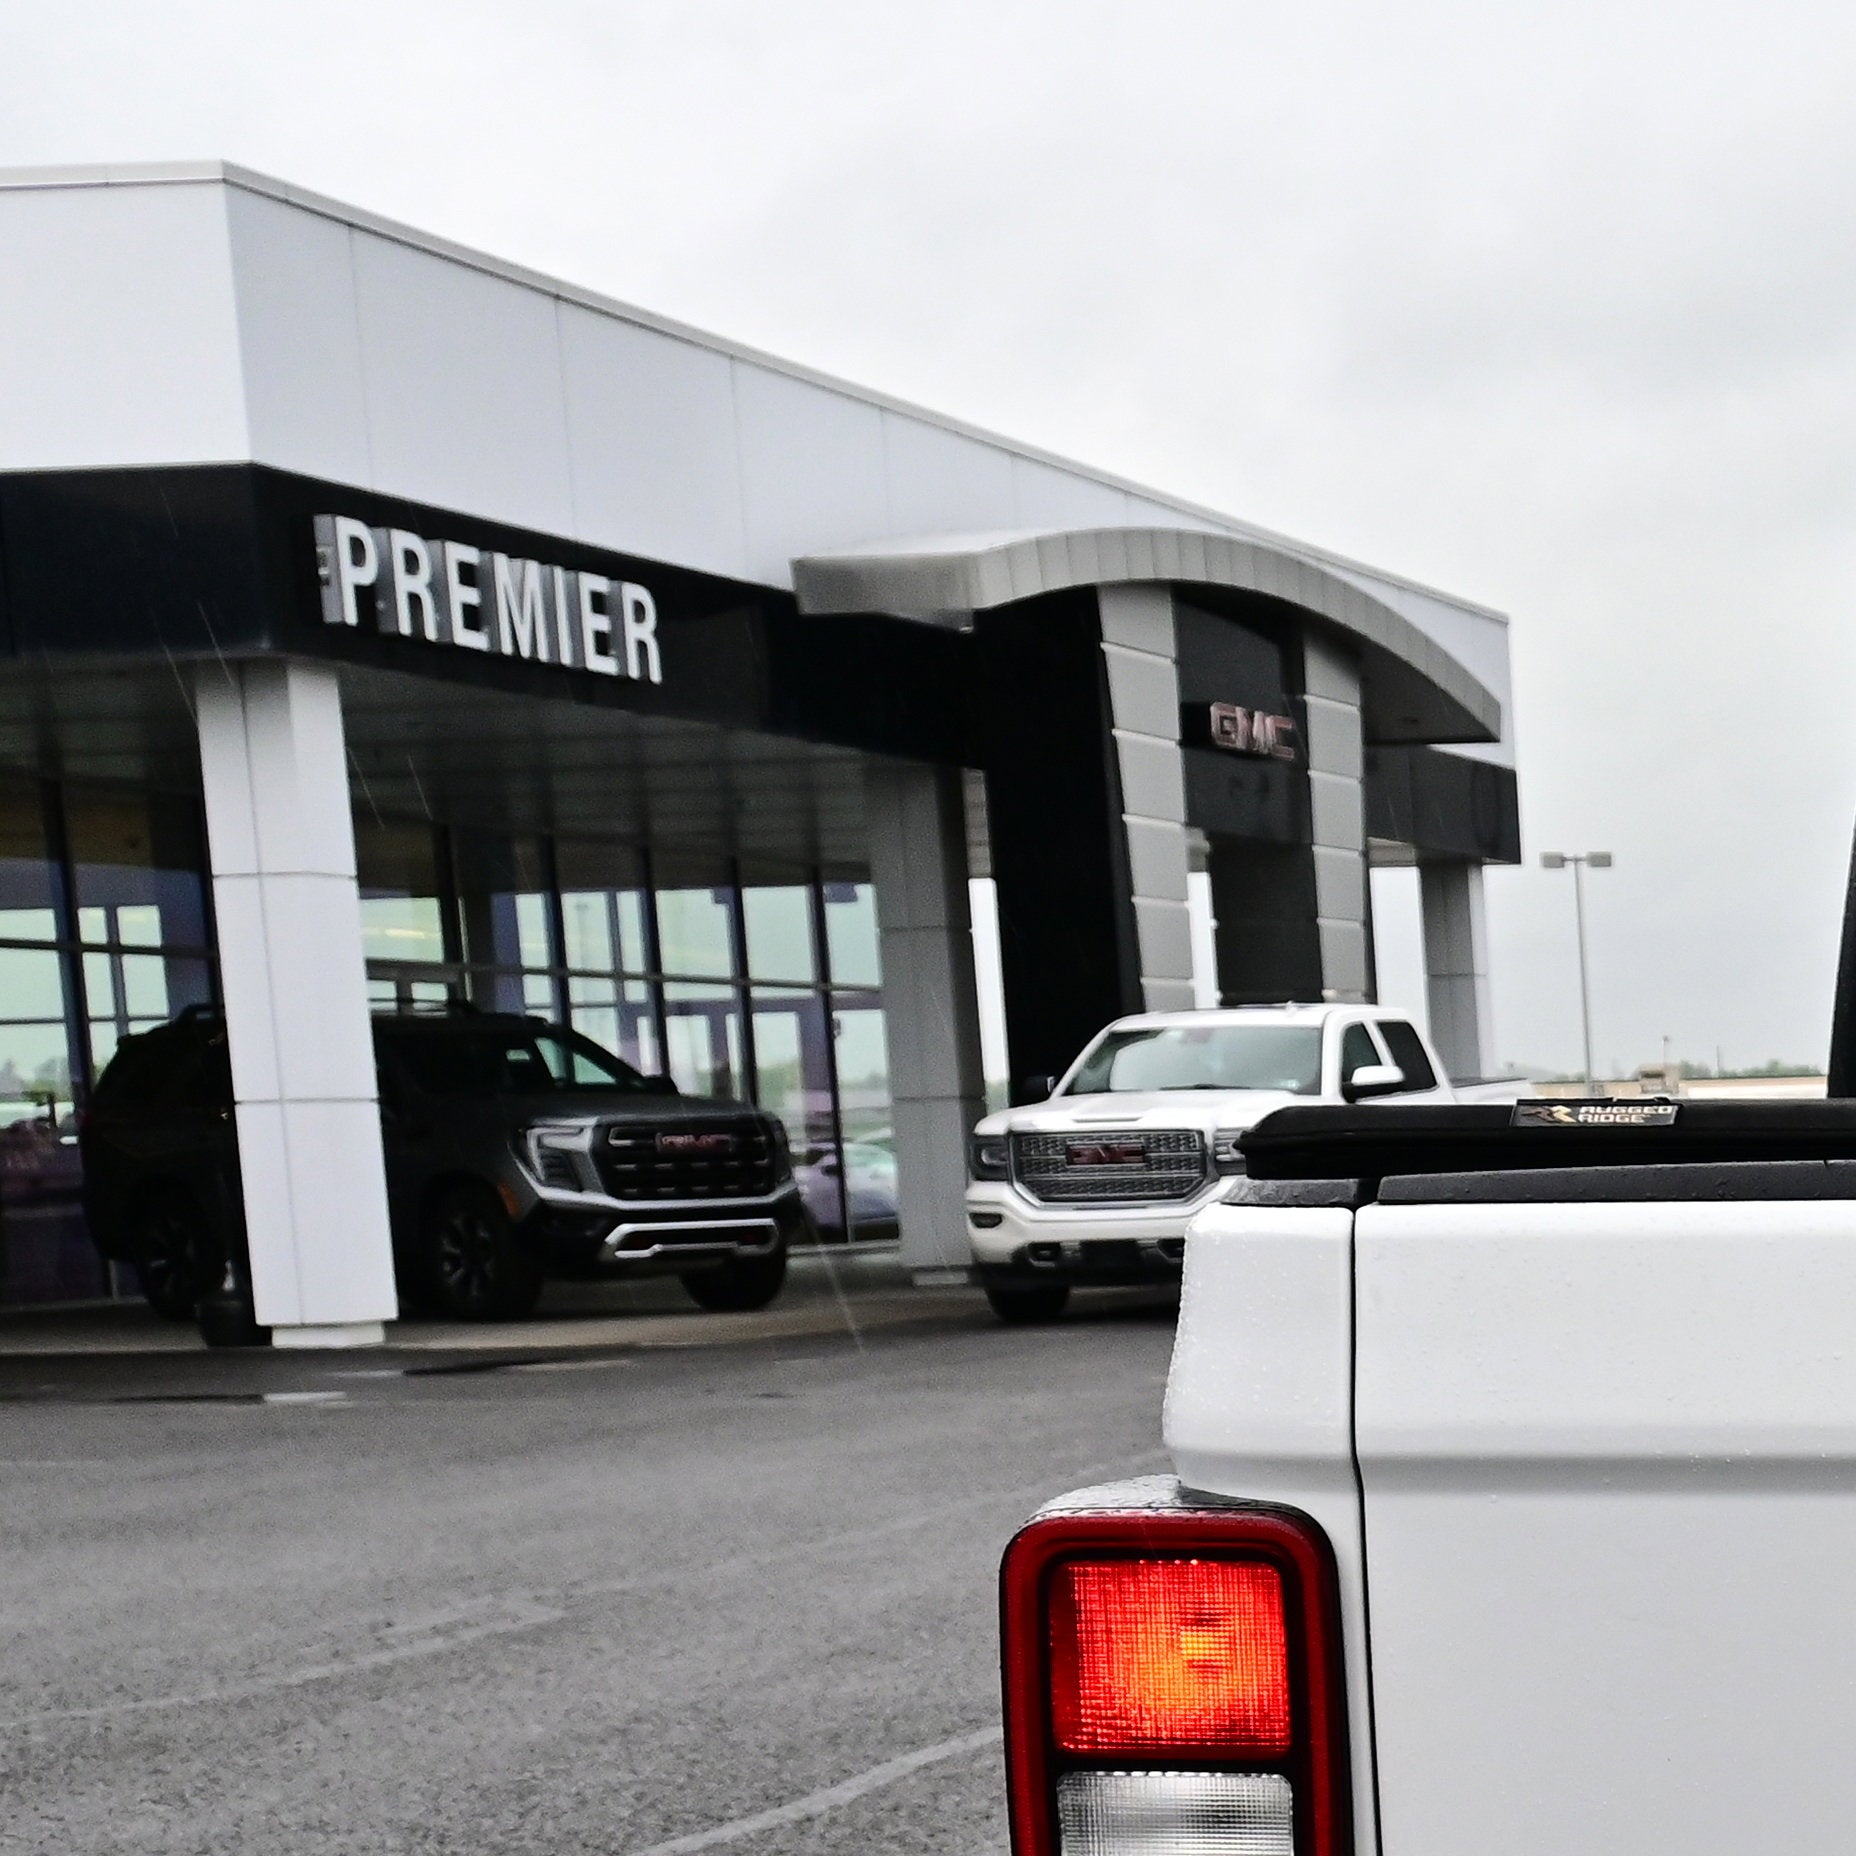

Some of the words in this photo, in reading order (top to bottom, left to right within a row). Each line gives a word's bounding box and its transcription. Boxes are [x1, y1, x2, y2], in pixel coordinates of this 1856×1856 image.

[315, 513, 663, 685] PREMIER
[1210, 702, 1295, 761] GMC
[1577, 1114, 1647, 1124] RIDGE
[1579, 1106, 1674, 1115] RUGGED
